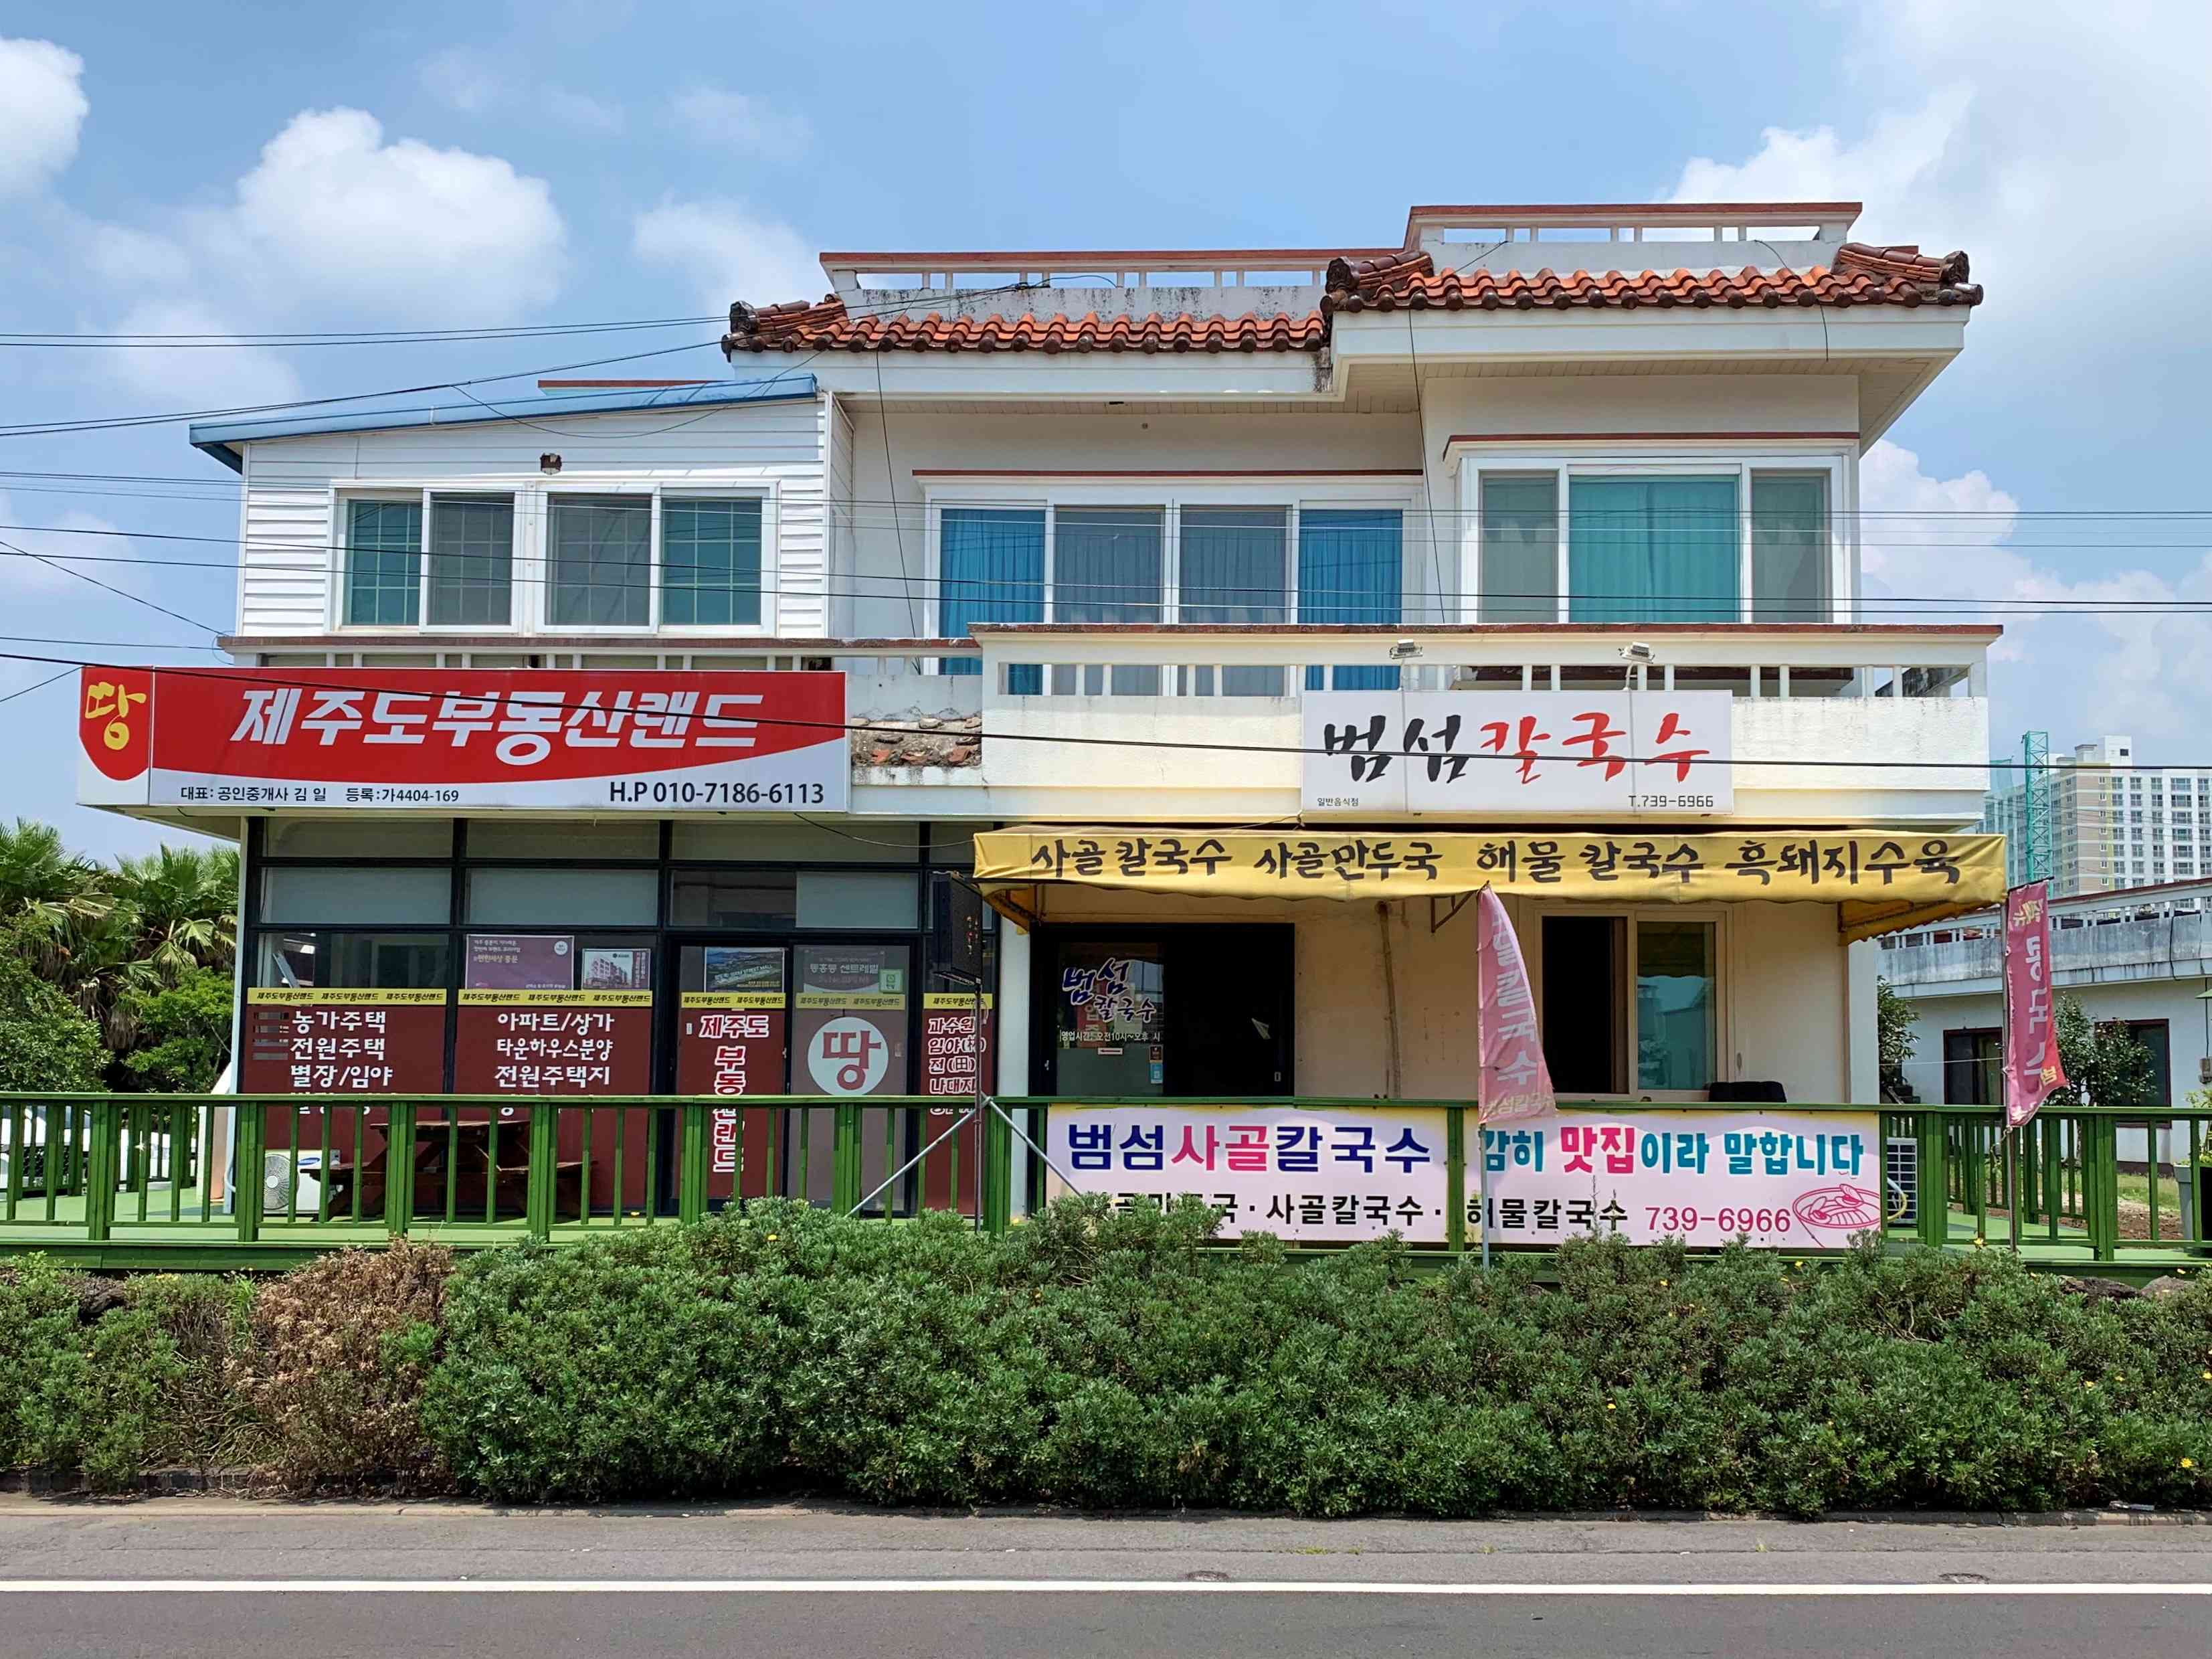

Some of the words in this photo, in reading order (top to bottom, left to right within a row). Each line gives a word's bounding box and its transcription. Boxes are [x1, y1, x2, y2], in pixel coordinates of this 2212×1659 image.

[84, 681, 147, 751] 땅
[229, 688, 763, 766] 제주도부동산랜드
[1323, 712, 1710, 784] 범섬칼국수
[181, 787, 214, 801] 대표:
[217, 787, 288, 801] 공인중개사
[294, 787, 307, 801] 김
[314, 788, 327, 801] 일
[610, 782, 647, 802] H.P
[654, 782, 824, 804] 010-7186-6113
[1317, 796, 1359, 807] 일반음식점
[1628, 794, 1714, 808] T.739-6966
[1254, 841, 1443, 881] 사골만두국
[1724, 839, 1960, 885] 흑돼지수육
[1062, 957, 1130, 1005] 범섬
[257, 992, 314, 1001] 제주도부동산랜드
[321, 992, 379, 1001] 제주도부동산랜드
[386, 992, 443, 1001] 제주도부동산랜드
[463, 993, 520, 1002] 제주도부동산랜드
[528, 993, 585, 1002] 제주도부동산랜드
[593, 994, 650, 1003] 제주도부동산랜드
[1093, 994, 1158, 1023] 칼국수
[292, 1011, 385, 1035] 농가주택
[498, 1013, 614, 1036] 아파트/상가
[699, 1015, 769, 1039] 제주도
[928, 1017, 975, 1034] 과수원
[290, 1038, 385, 1061] 전원주택
[496, 1039, 613, 1061] 타운하우스분양
[822, 1030, 882, 1090] 땅
[291, 1065, 393, 1088] 별장/임야
[494, 1065, 610, 1088] 전원주택지
[1069, 1124, 1431, 1173] 범섬사골칼국수
[1484, 1129, 1544, 1172] 감히
[1560, 1126, 1710, 1175] 맛집이라
[1724, 1130, 1863, 1176] 말합니다
[1645, 1206, 1791, 1233] 739-6966
